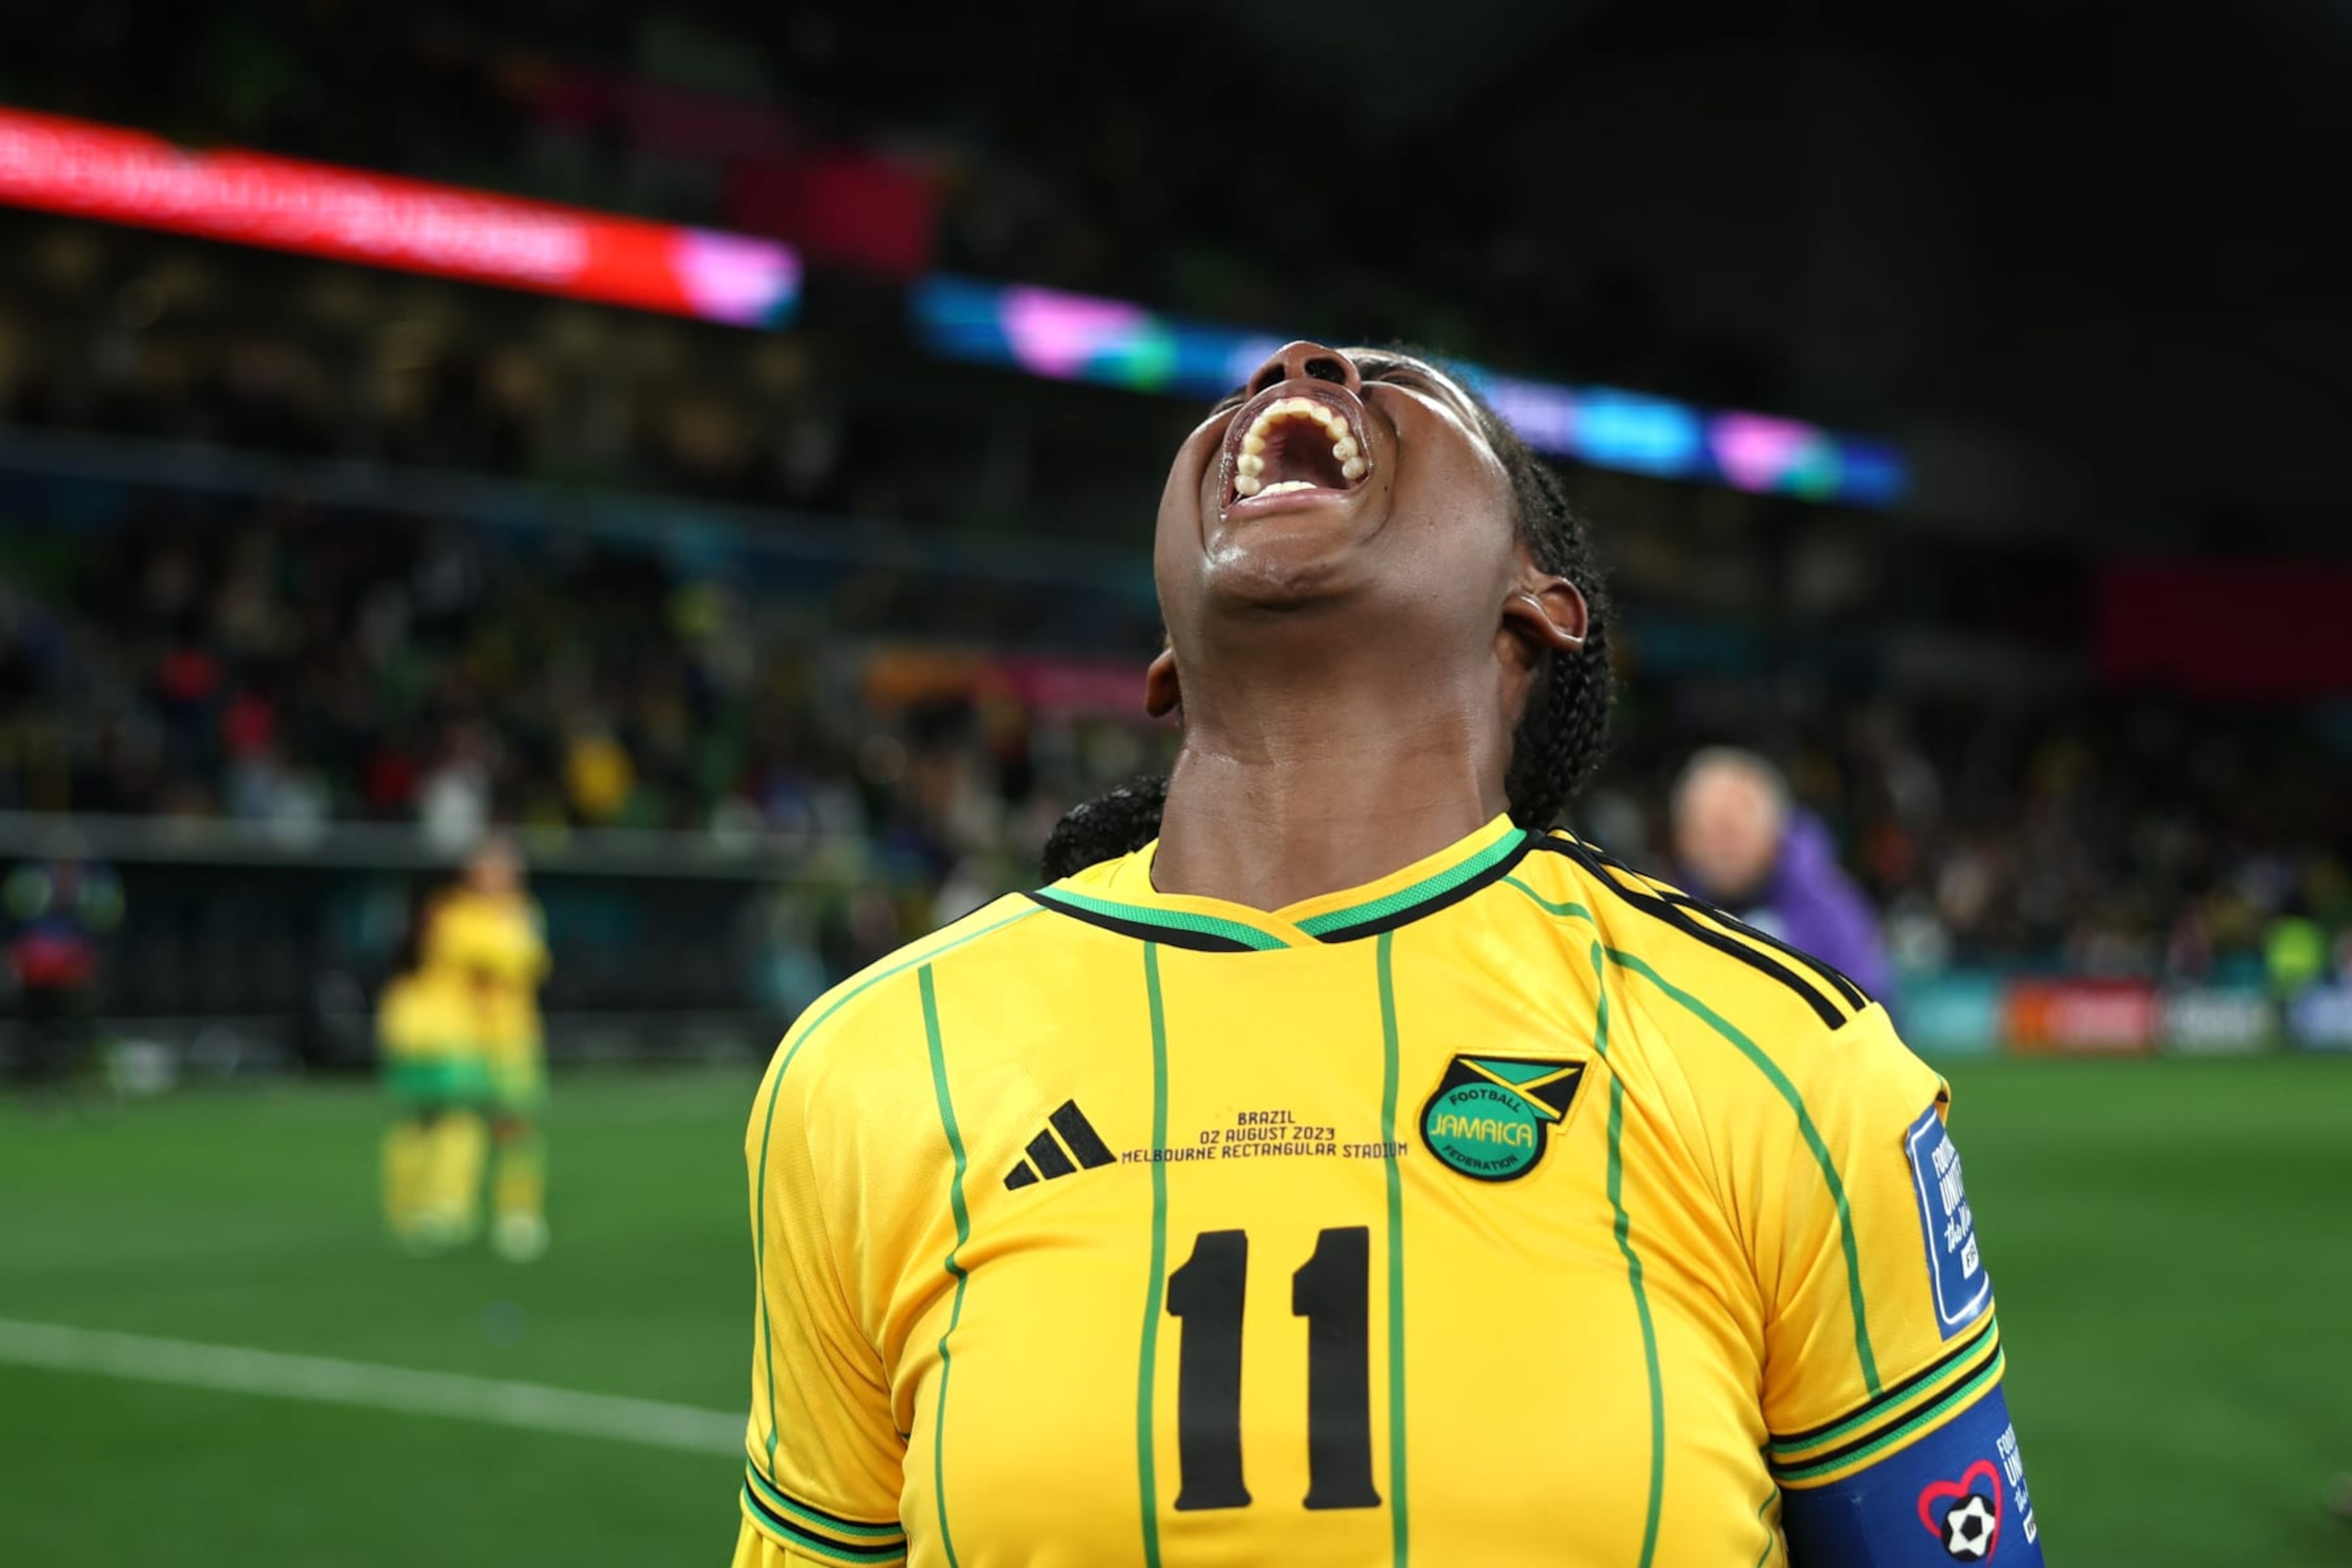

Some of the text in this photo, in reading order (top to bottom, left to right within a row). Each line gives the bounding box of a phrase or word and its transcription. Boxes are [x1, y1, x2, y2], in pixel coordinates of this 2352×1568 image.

[1450, 1089, 1521, 1114] FOOTBALL
[1237, 1110, 1296, 1126] BRAZIL
[1200, 1126, 1335, 1145] 02 AUGUST 2023
[1431, 1114, 1532, 1148] JAMAICA
[1121, 1142, 1408, 1164] MELBOURNE RECTANGULAR STADIUM
[1442, 1145, 1520, 1171] FEDERATION
[1166, 1225, 1383, 1512] 11
